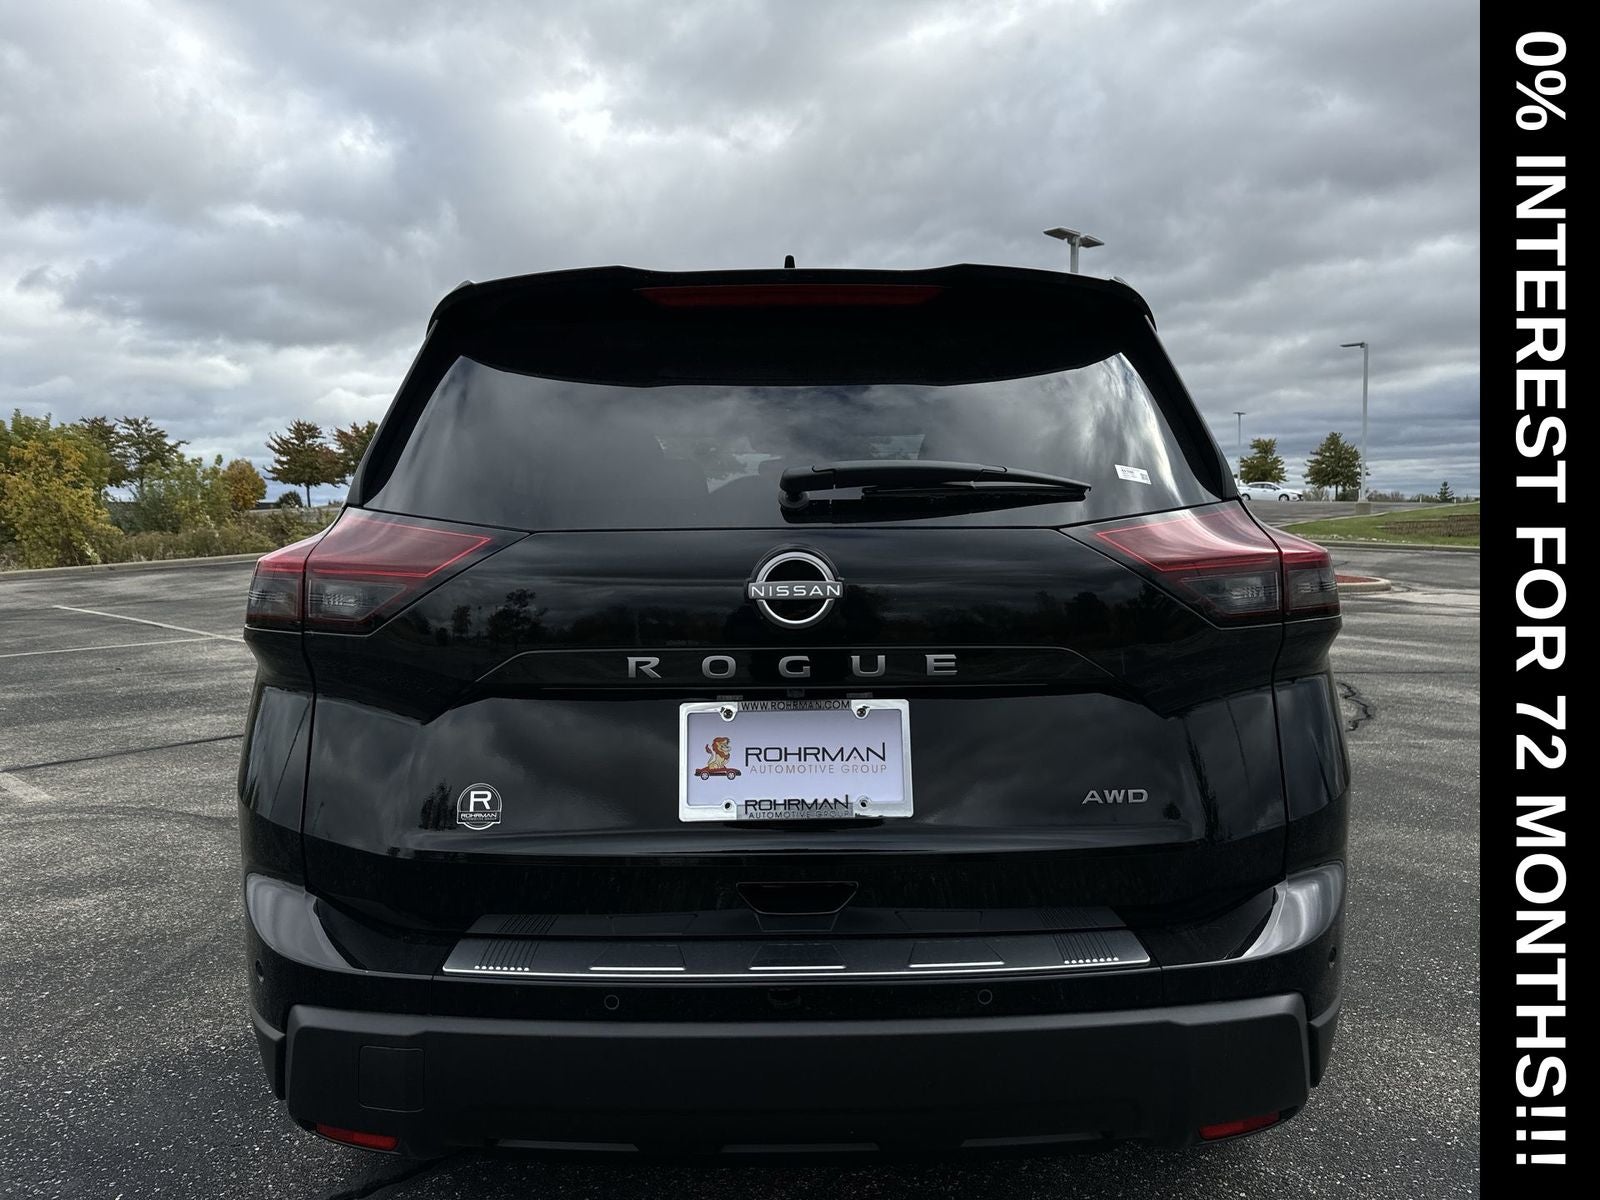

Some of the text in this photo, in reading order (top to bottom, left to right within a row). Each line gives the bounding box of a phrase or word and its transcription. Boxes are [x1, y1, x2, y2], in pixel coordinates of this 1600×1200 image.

[751, 585, 841, 597] NISSAN
[627, 654, 958, 678] ROGUE
[740, 700, 850, 711] WWW.ROHRMAN.COM
[745, 742, 886, 767] ROHRMAN
[750, 764, 887, 774] AUTOMOTIVE GROUP
[470, 791, 492, 812] R
[744, 794, 849, 814] ROHRMAN
[1082, 789, 1149, 804] AWD
[748, 810, 850, 819] AUTOMOTIVE GROUP
